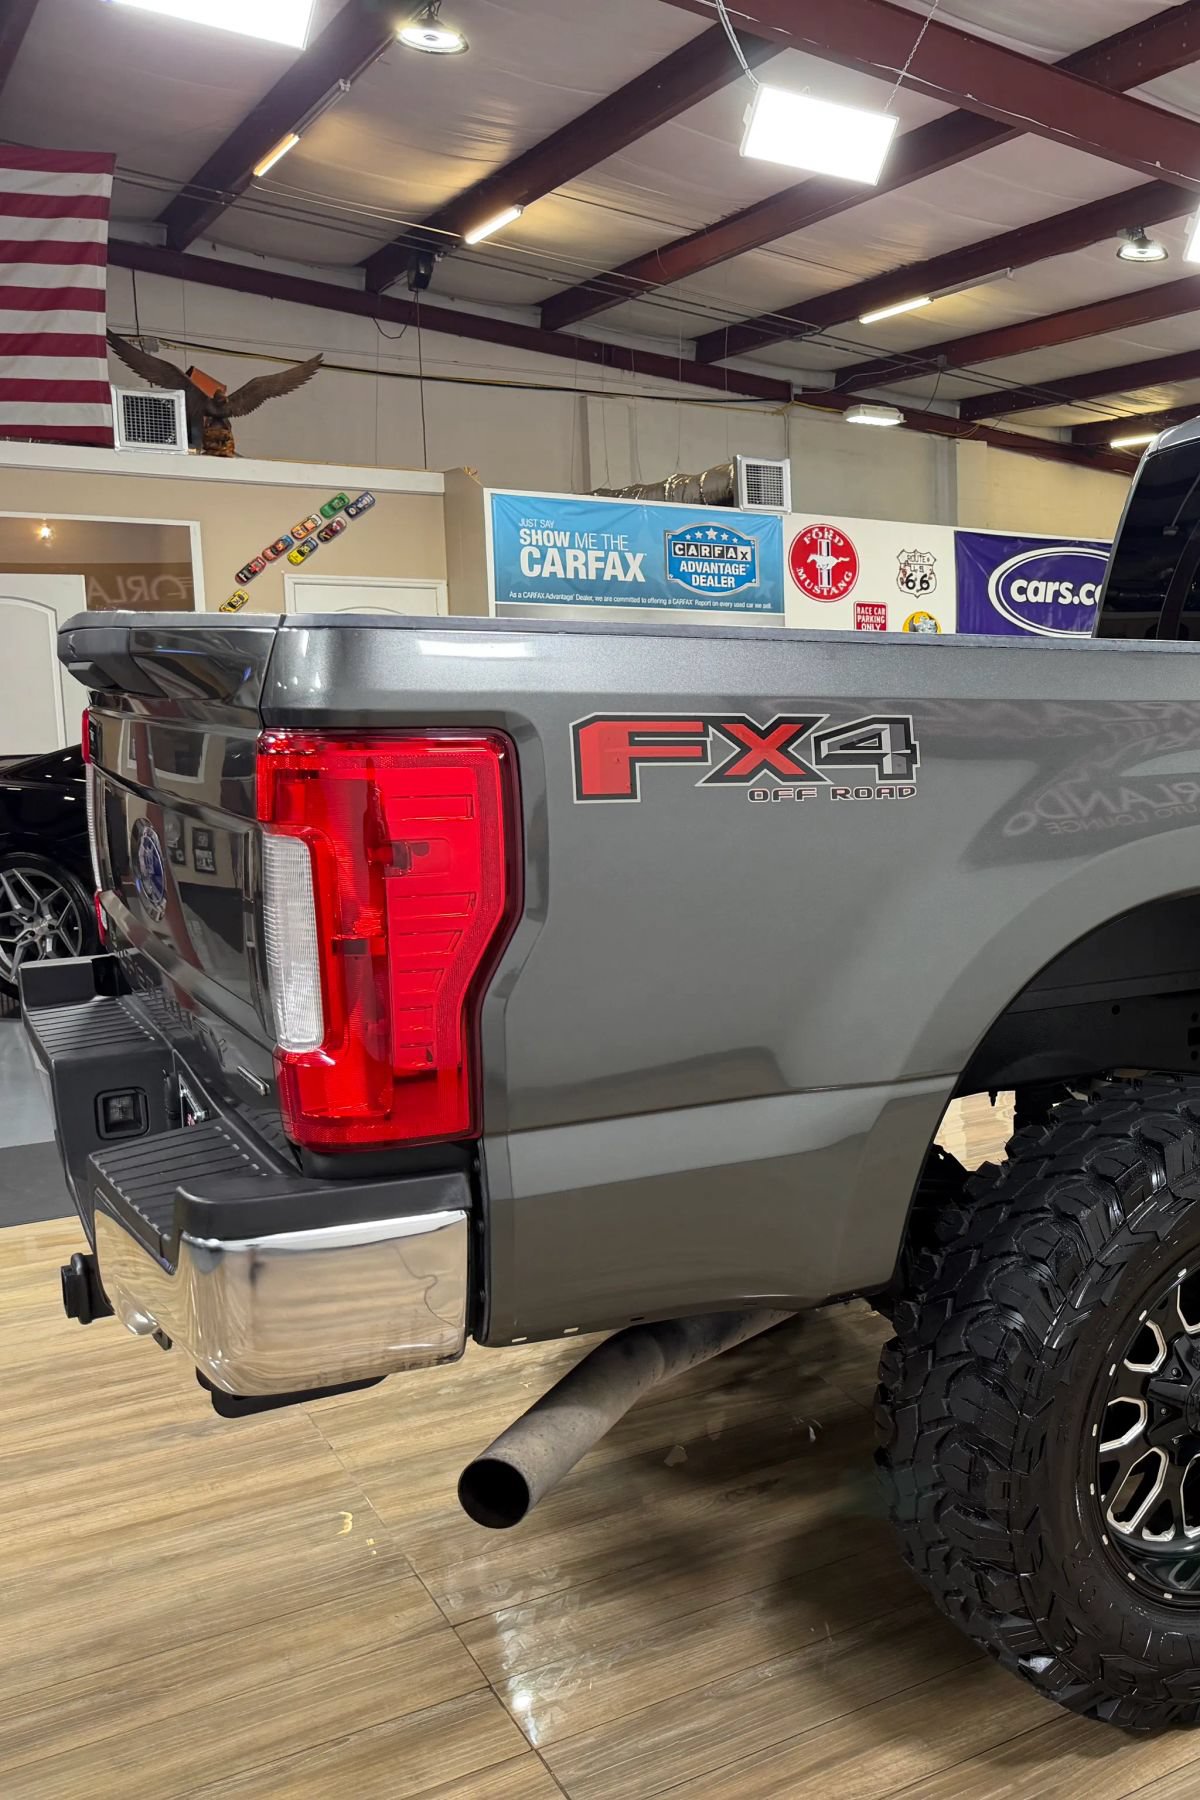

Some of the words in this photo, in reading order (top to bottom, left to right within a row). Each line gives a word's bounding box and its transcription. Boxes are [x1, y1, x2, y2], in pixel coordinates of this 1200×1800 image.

[518, 518, 537, 528] JUST
[540, 519, 555, 529] SAY
[519, 528, 571, 548] SHOW
[575, 532, 597, 549] ME
[601, 533, 629, 551] THE
[803, 528, 845, 547] FORD
[674, 543, 749, 561] CARFAX
[520, 546, 646, 583] CARFAX
[679, 560, 747, 576] ADVANTAGE
[691, 575, 736, 589] DEALER
[796, 567, 853, 597] MUSTANG
[905, 573, 930, 591] 66
[857, 606, 872, 615] RACE
[873, 607, 885, 616] CAR
[857, 614, 885, 624] PARKING
[861, 623, 881, 631] ONLY
[570, 712, 920, 804] FX4
[747, 787, 817, 803] OFF
[830, 786, 918, 801] ROAD
